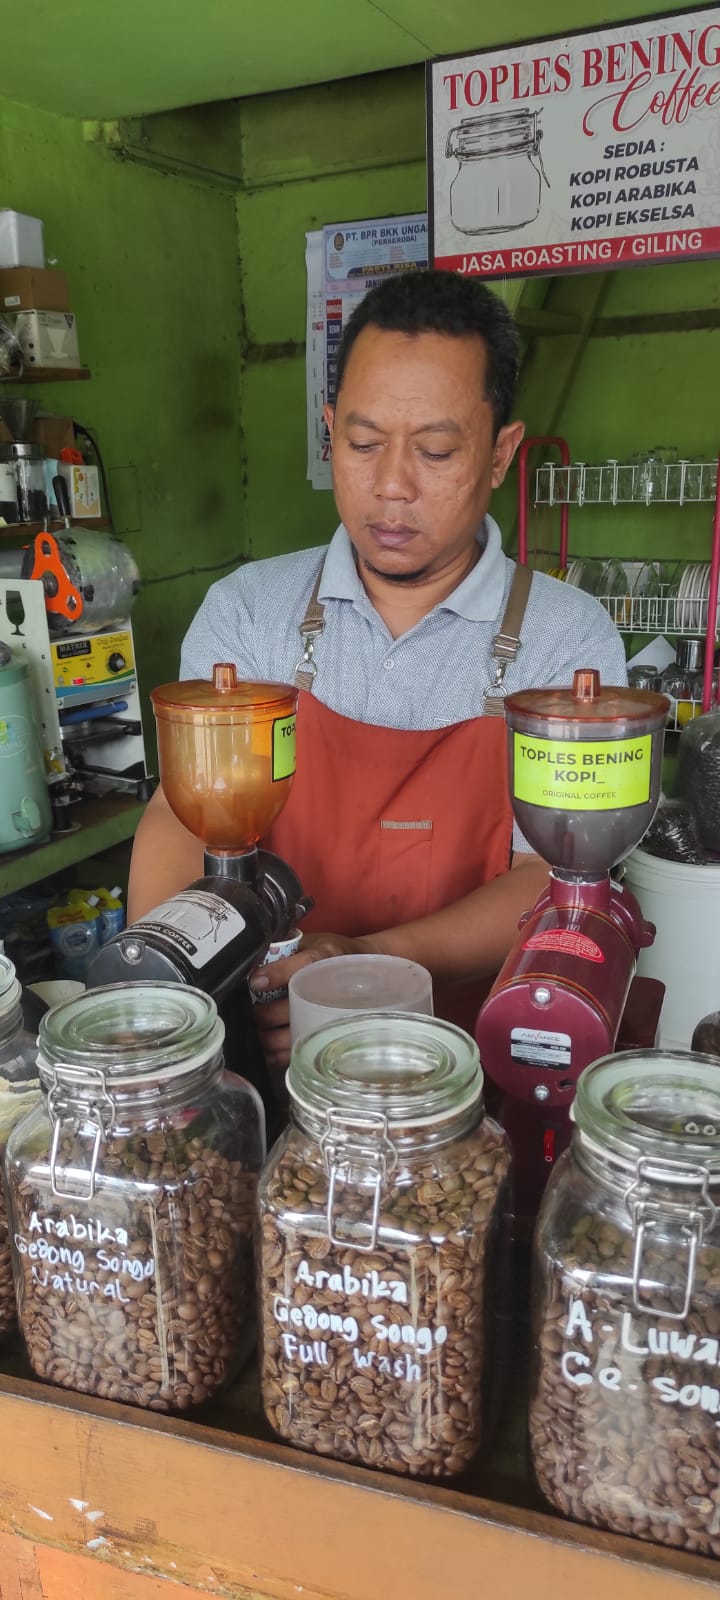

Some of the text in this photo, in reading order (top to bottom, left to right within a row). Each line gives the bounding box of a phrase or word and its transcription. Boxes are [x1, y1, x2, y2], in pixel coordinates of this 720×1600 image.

[443, 25, 720, 110] TOPLES BENING
[582, 66, 720, 136] Coffee
[603, 139, 656, 160] SEDIA
[569, 156, 699, 187] KOPI ROBUSTA
[570, 180, 697, 209] KOPI ARABIKA
[345, 223, 427, 241] PT. BPR BKK UNGA
[570, 203, 695, 231] KOPI EKSELSA
[457, 253, 506, 274] JASA
[511, 241, 612, 269] ROASTING
[632, 232, 702, 256] GILING
[520, 746, 643, 765] TOPLES BENING
[543, 789, 616, 799] ORIGINAL COFFEE
[29, 1211, 128, 1246] Arabika
[295, 1260, 408, 1303] Arabika
[273, 1295, 448, 1355] Gedong Songo
[282, 1333, 329, 1365] Full
